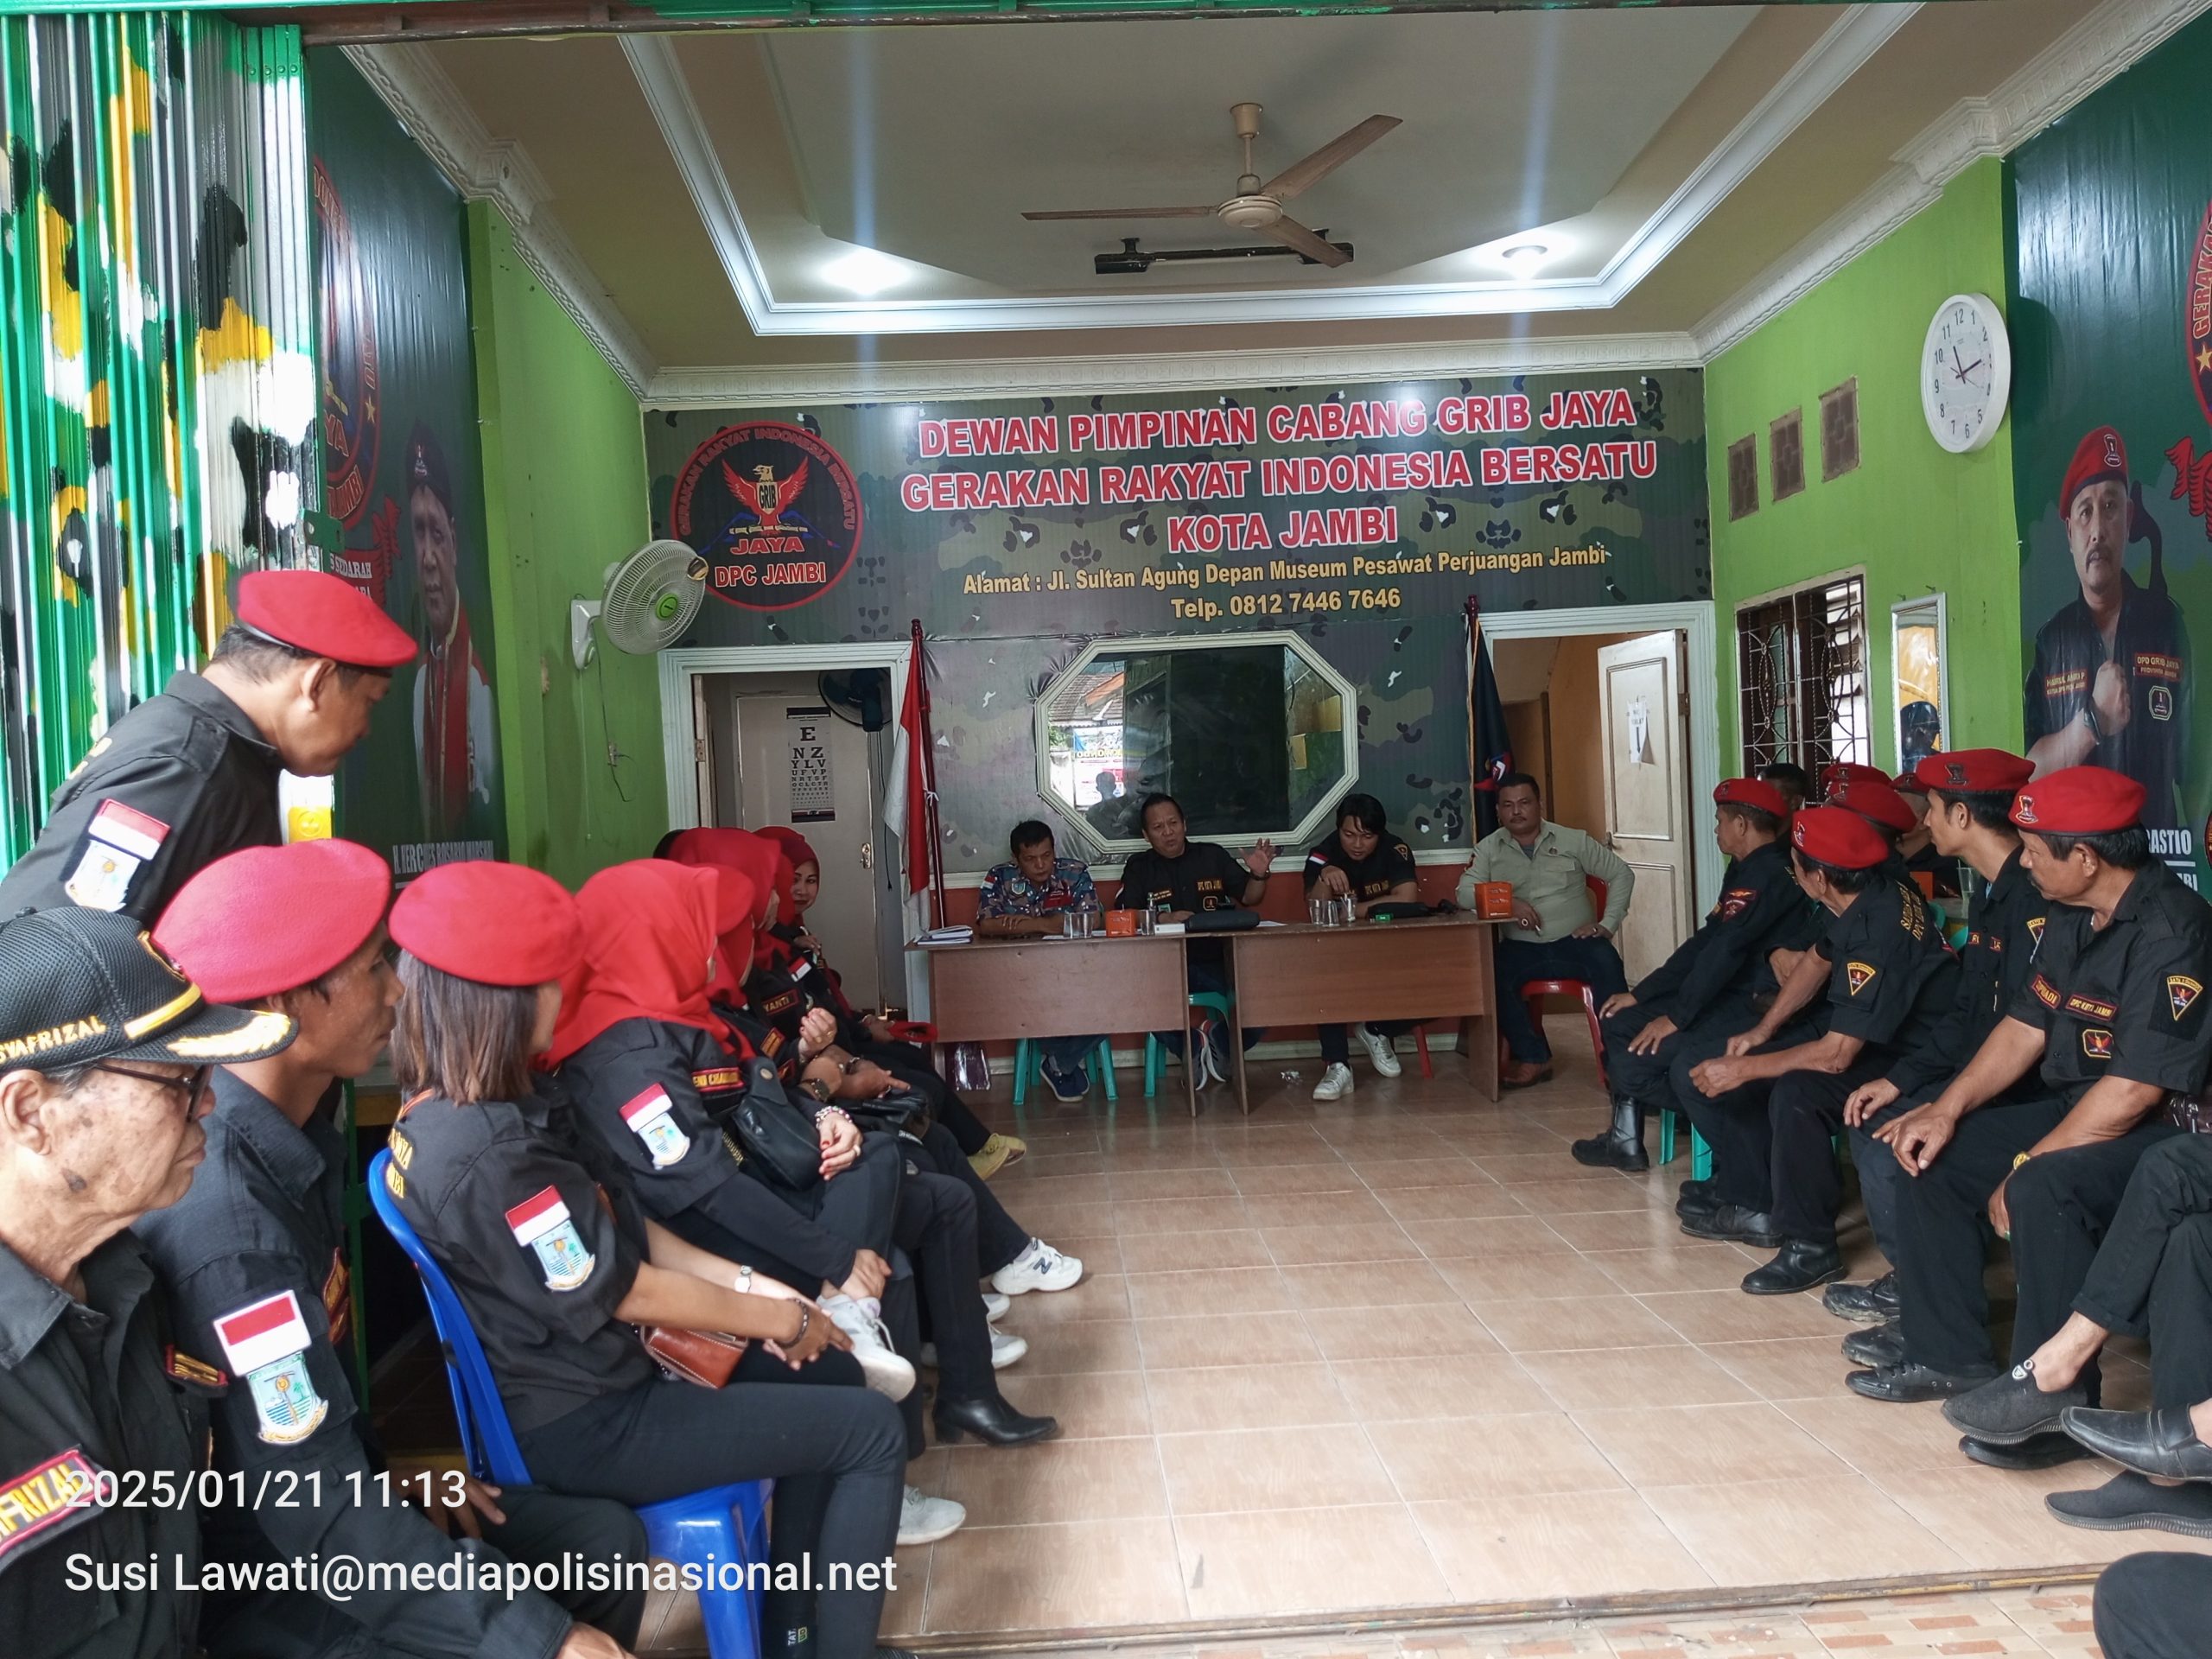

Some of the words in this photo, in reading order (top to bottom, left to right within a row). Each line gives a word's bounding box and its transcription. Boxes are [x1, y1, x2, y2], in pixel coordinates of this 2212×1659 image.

[2192, 214, 2212, 339] GERAKA
[1955, 308, 1964, 326] 12
[1942, 323, 1951, 340] 11
[1982, 327, 1988, 341] 2
[1935, 348, 1943, 365] 10
[1935, 379, 1940, 393] 9
[1940, 404, 1945, 418] 8
[1977, 409, 1983, 424] 5
[918, 415, 1058, 457] DEWAN
[1070, 406, 1257, 452] PIMPINAN
[1268, 398, 1427, 443] CABANG
[1436, 395, 1531, 434] GRIB
[1540, 389, 1637, 429] JAYA
[1950, 420, 1955, 435] 7
[1965, 423, 1970, 439] 6
[677, 465, 703, 536] GERAKAN
[698, 429, 751, 467] RAKYAT
[754, 428, 830, 464] INDONESIA
[828, 462, 855, 531] BERSATU
[900, 467, 1090, 512] GERAKAN
[1100, 460, 1251, 504] RAKYAT
[1261, 450, 1477, 496] INDONESIA
[1481, 441, 1657, 486] BERSATU
[759, 484, 777, 510] GRIB
[1167, 514, 1272, 553] KOTA
[1279, 505, 1399, 550] JAMBI
[730, 536, 804, 555] JAYA
[715, 564, 757, 588] DPC
[761, 561, 826, 585] JAMBI
[963, 573, 1031, 595] Alamat
[1075, 567, 1135, 591] Sultan
[1141, 568, 1200, 592] Agung
[1205, 561, 1264, 588] Depan
[1269, 558, 1348, 582] Museum
[1352, 554, 1433, 577] Pesawat
[1438, 550, 1544, 577] Perjuangan
[1548, 544, 1606, 567] Jambi
[1171, 597, 1224, 621] Telp.
[1230, 593, 1283, 616] 0812
[1288, 590, 1342, 613] 7446
[1347, 588, 1402, 610] 7646
[800, 727, 816, 741] E
[793, 747, 805, 759] N
[810, 747, 823, 759] Z
[791, 760, 800, 768] Y
[804, 760, 813, 768] L
